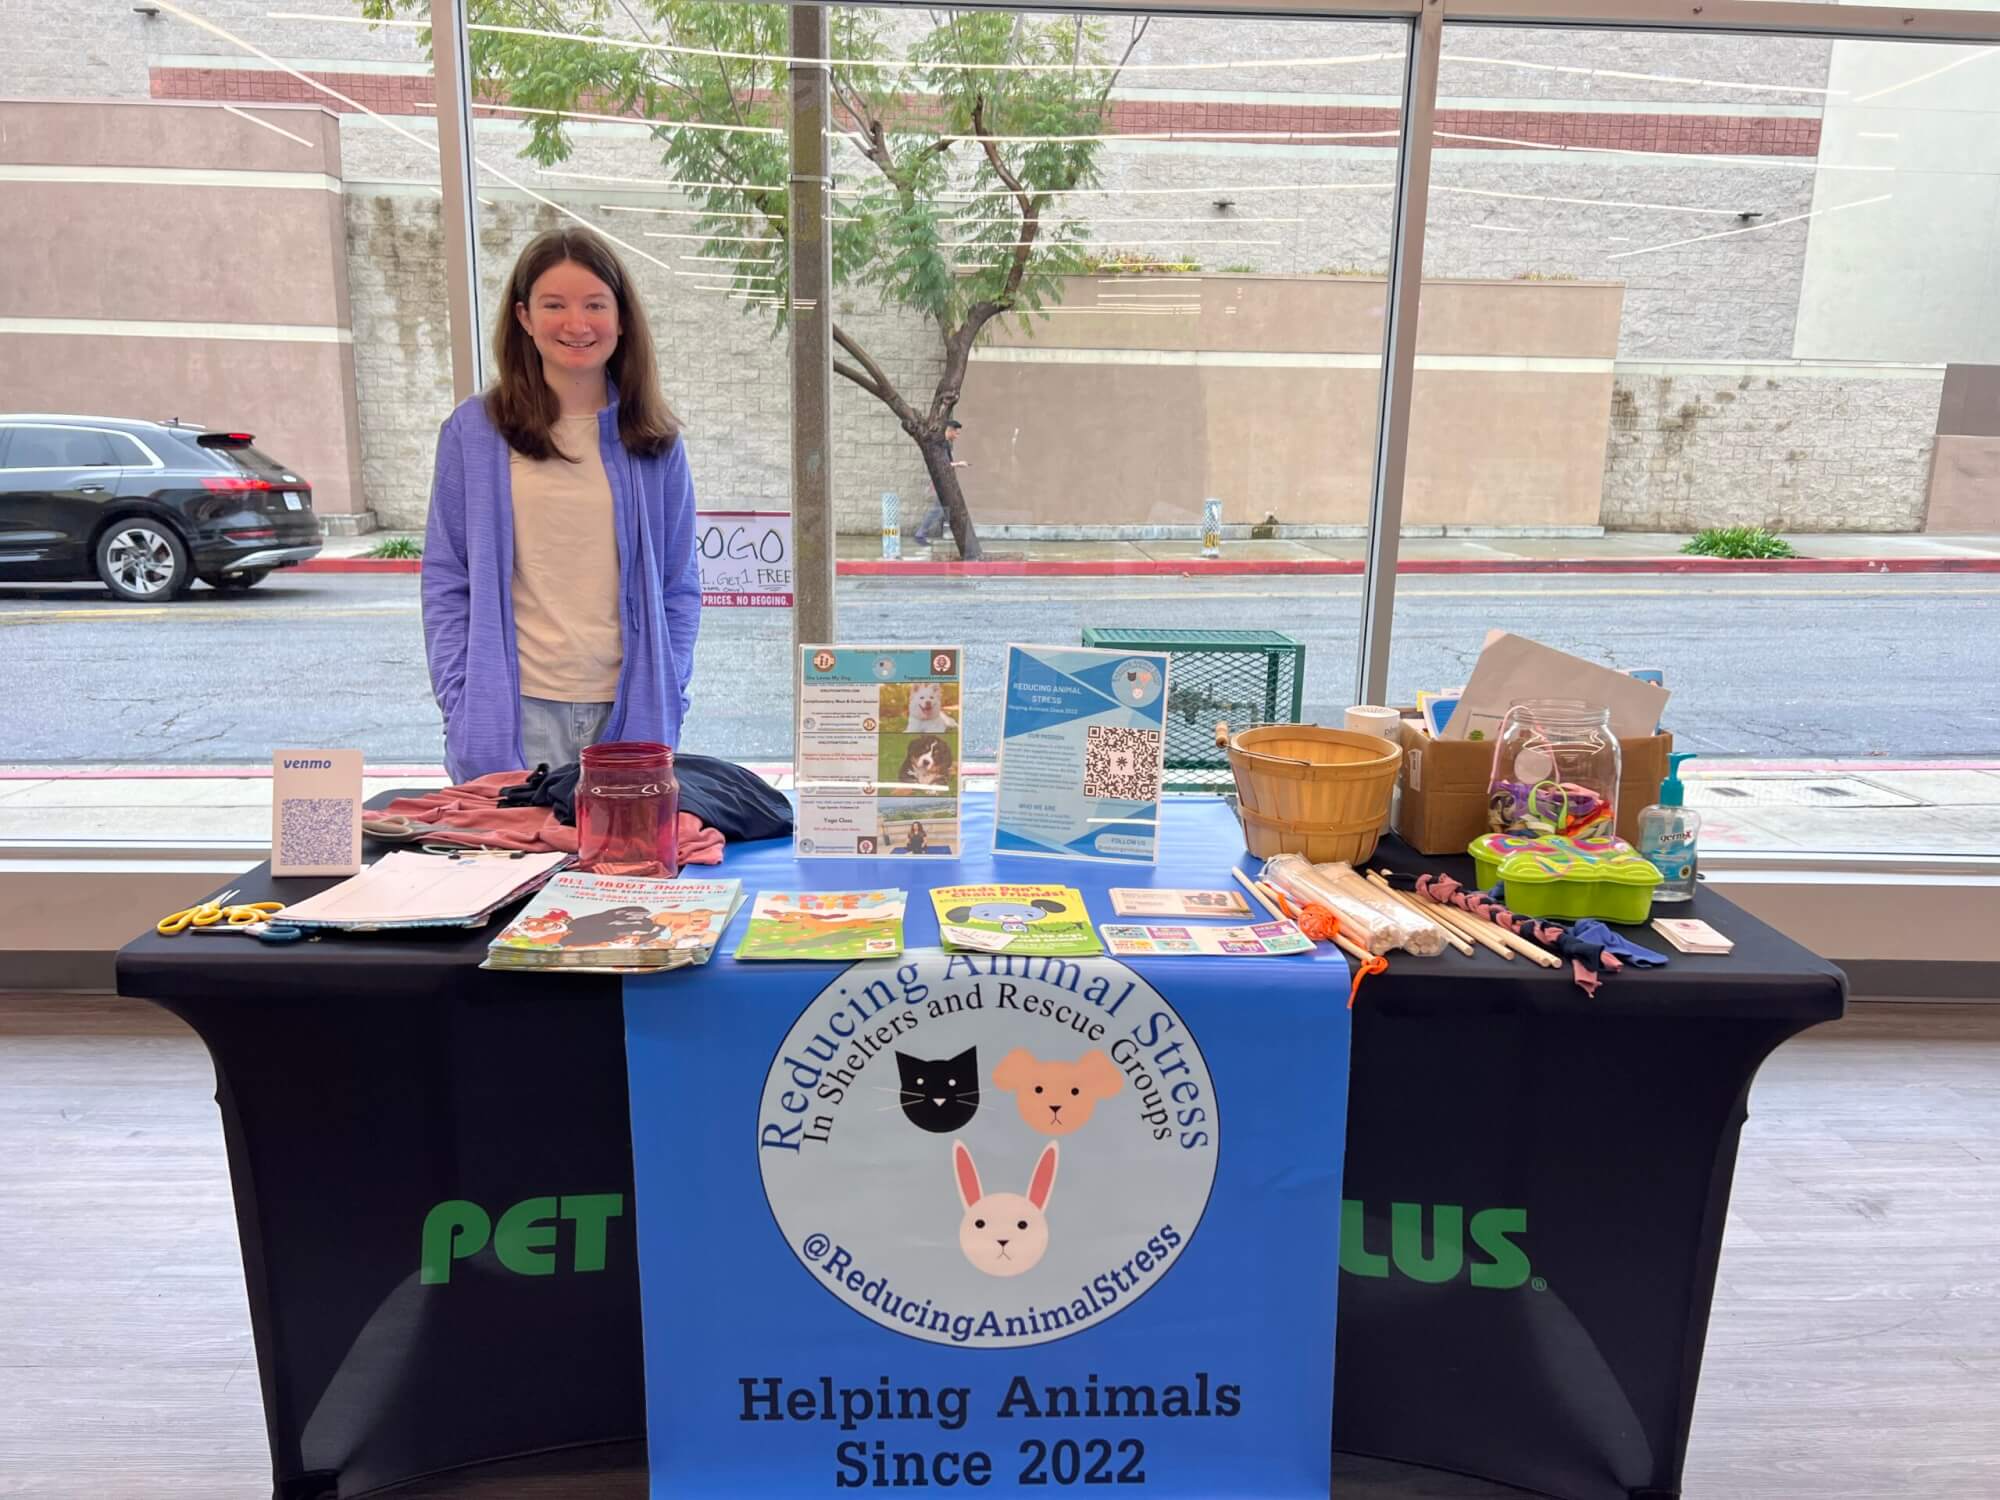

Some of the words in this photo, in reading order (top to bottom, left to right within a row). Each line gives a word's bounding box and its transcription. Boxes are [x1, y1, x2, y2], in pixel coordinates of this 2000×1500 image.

[757, 568, 792, 585] FREE
[736, 595, 749, 605] NO
[750, 595, 789, 606] BEGGING.
[1013, 683, 1052, 693] REDUCING
[1053, 686, 1081, 695] ANIMAL
[1031, 695, 1062, 705] STRESS
[283, 759, 332, 769] venmo
[558, 877, 585, 886] ALL
[594, 881, 647, 890] ABOUT
[653, 883, 727, 891] ANIMALS
[936, 886, 996, 895] Friends
[927, 983, 984, 1020] and
[998, 982, 1107, 1041] Rescue
[760, 961, 929, 1155] Reducing
[942, 954, 1136, 1018] Animal
[1130, 1011, 1209, 1150] Stress
[818, 1007, 919, 1105] Shelters
[1110, 1038, 1173, 1141] Groups
[802, 1114, 835, 1144] In
[420, 1193, 624, 1285] PET
[1339, 1199, 1532, 1289] LUS
[802, 1224, 1182, 1342] @ReducingAnimalStress
[738, 1375, 971, 1431] Helping
[996, 1372, 1241, 1419] Animals
[836, 1439, 992, 1488] Since
[1018, 1438, 1146, 1486] 2022
